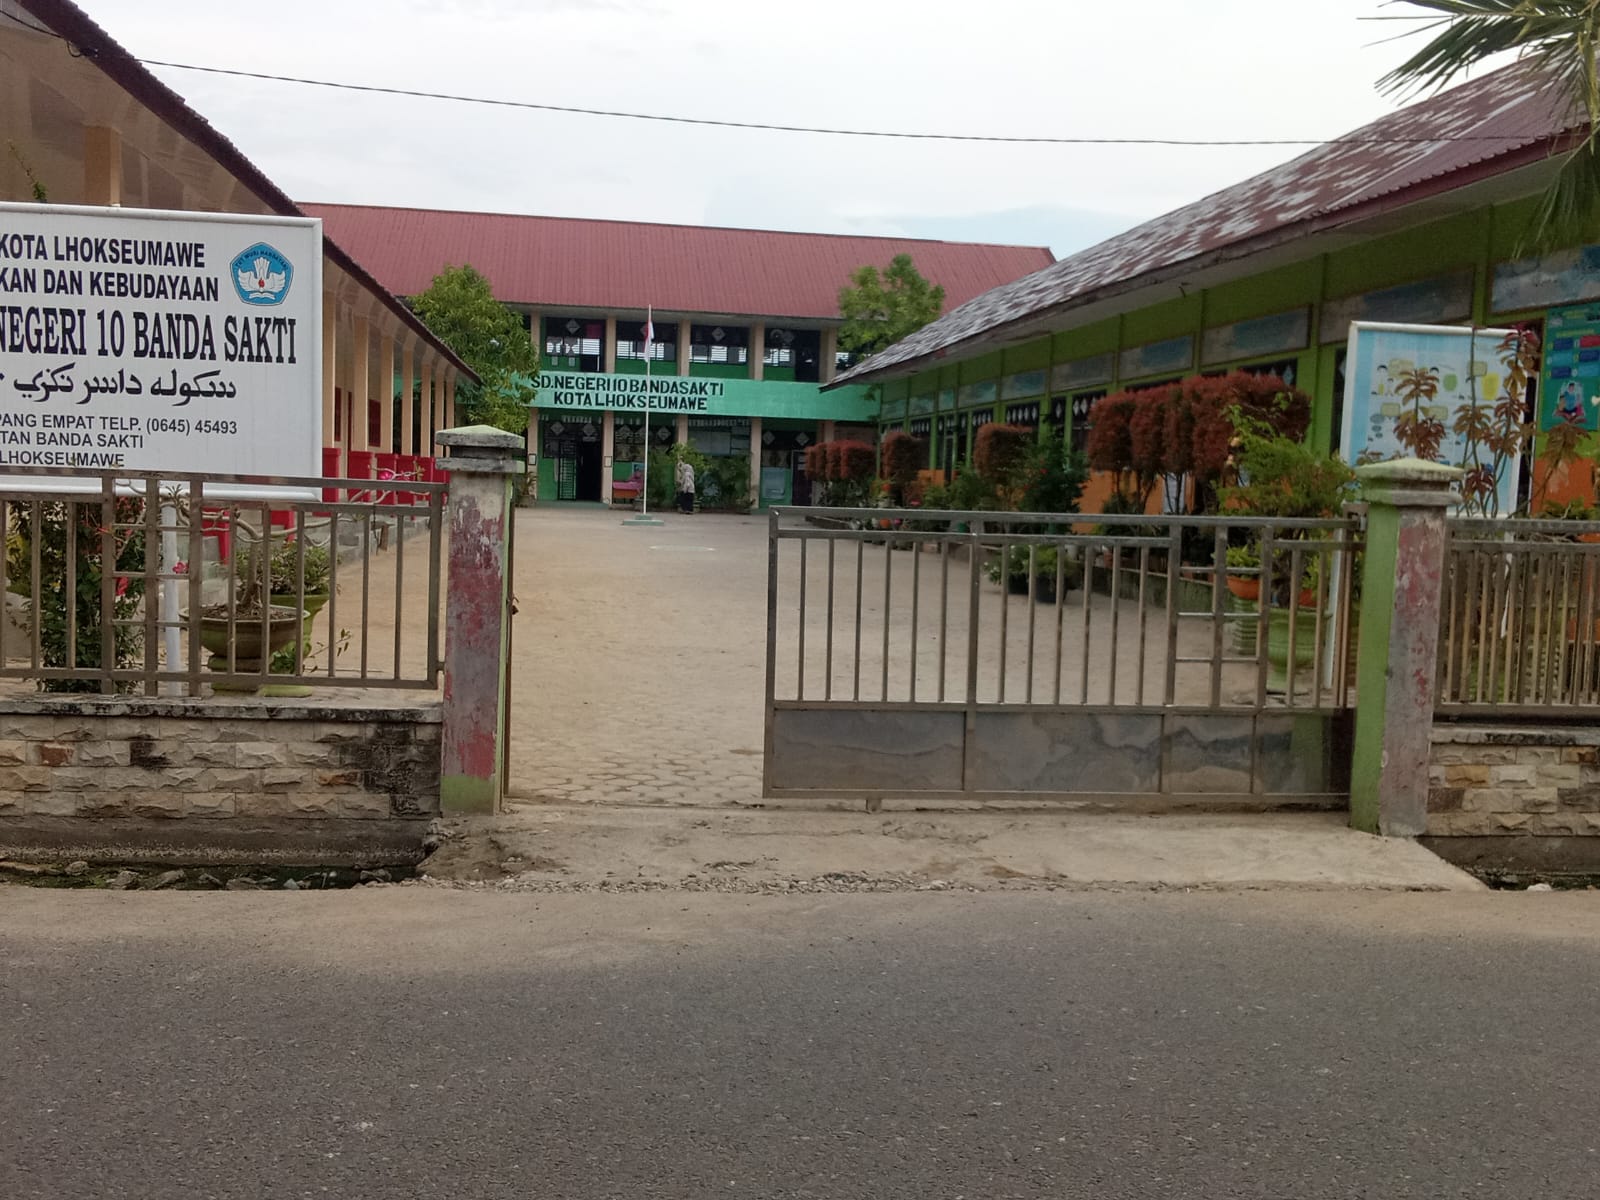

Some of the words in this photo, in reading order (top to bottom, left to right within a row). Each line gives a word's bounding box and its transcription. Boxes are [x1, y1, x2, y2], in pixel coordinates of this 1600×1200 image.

[54, 235, 205, 268] LHOKSEUMAWE
[44, 269, 82, 295] DAN
[90, 271, 219, 302] KEBUDAYAAN
[97, 309, 125, 357] 10
[133, 311, 217, 361] BANDA
[224, 315, 297, 364] SAKTI
[554, 391, 592, 406] KOTA
[595, 392, 708, 411] LHOKSEUMAWE
[42, 414, 95, 430] EMPAT
[99, 416, 142, 432] TELP.
[146, 417, 191, 436] (0645)
[195, 419, 237, 435] 45493
[36, 431, 93, 447] BANDA
[97, 433, 144, 449] SAKTI
